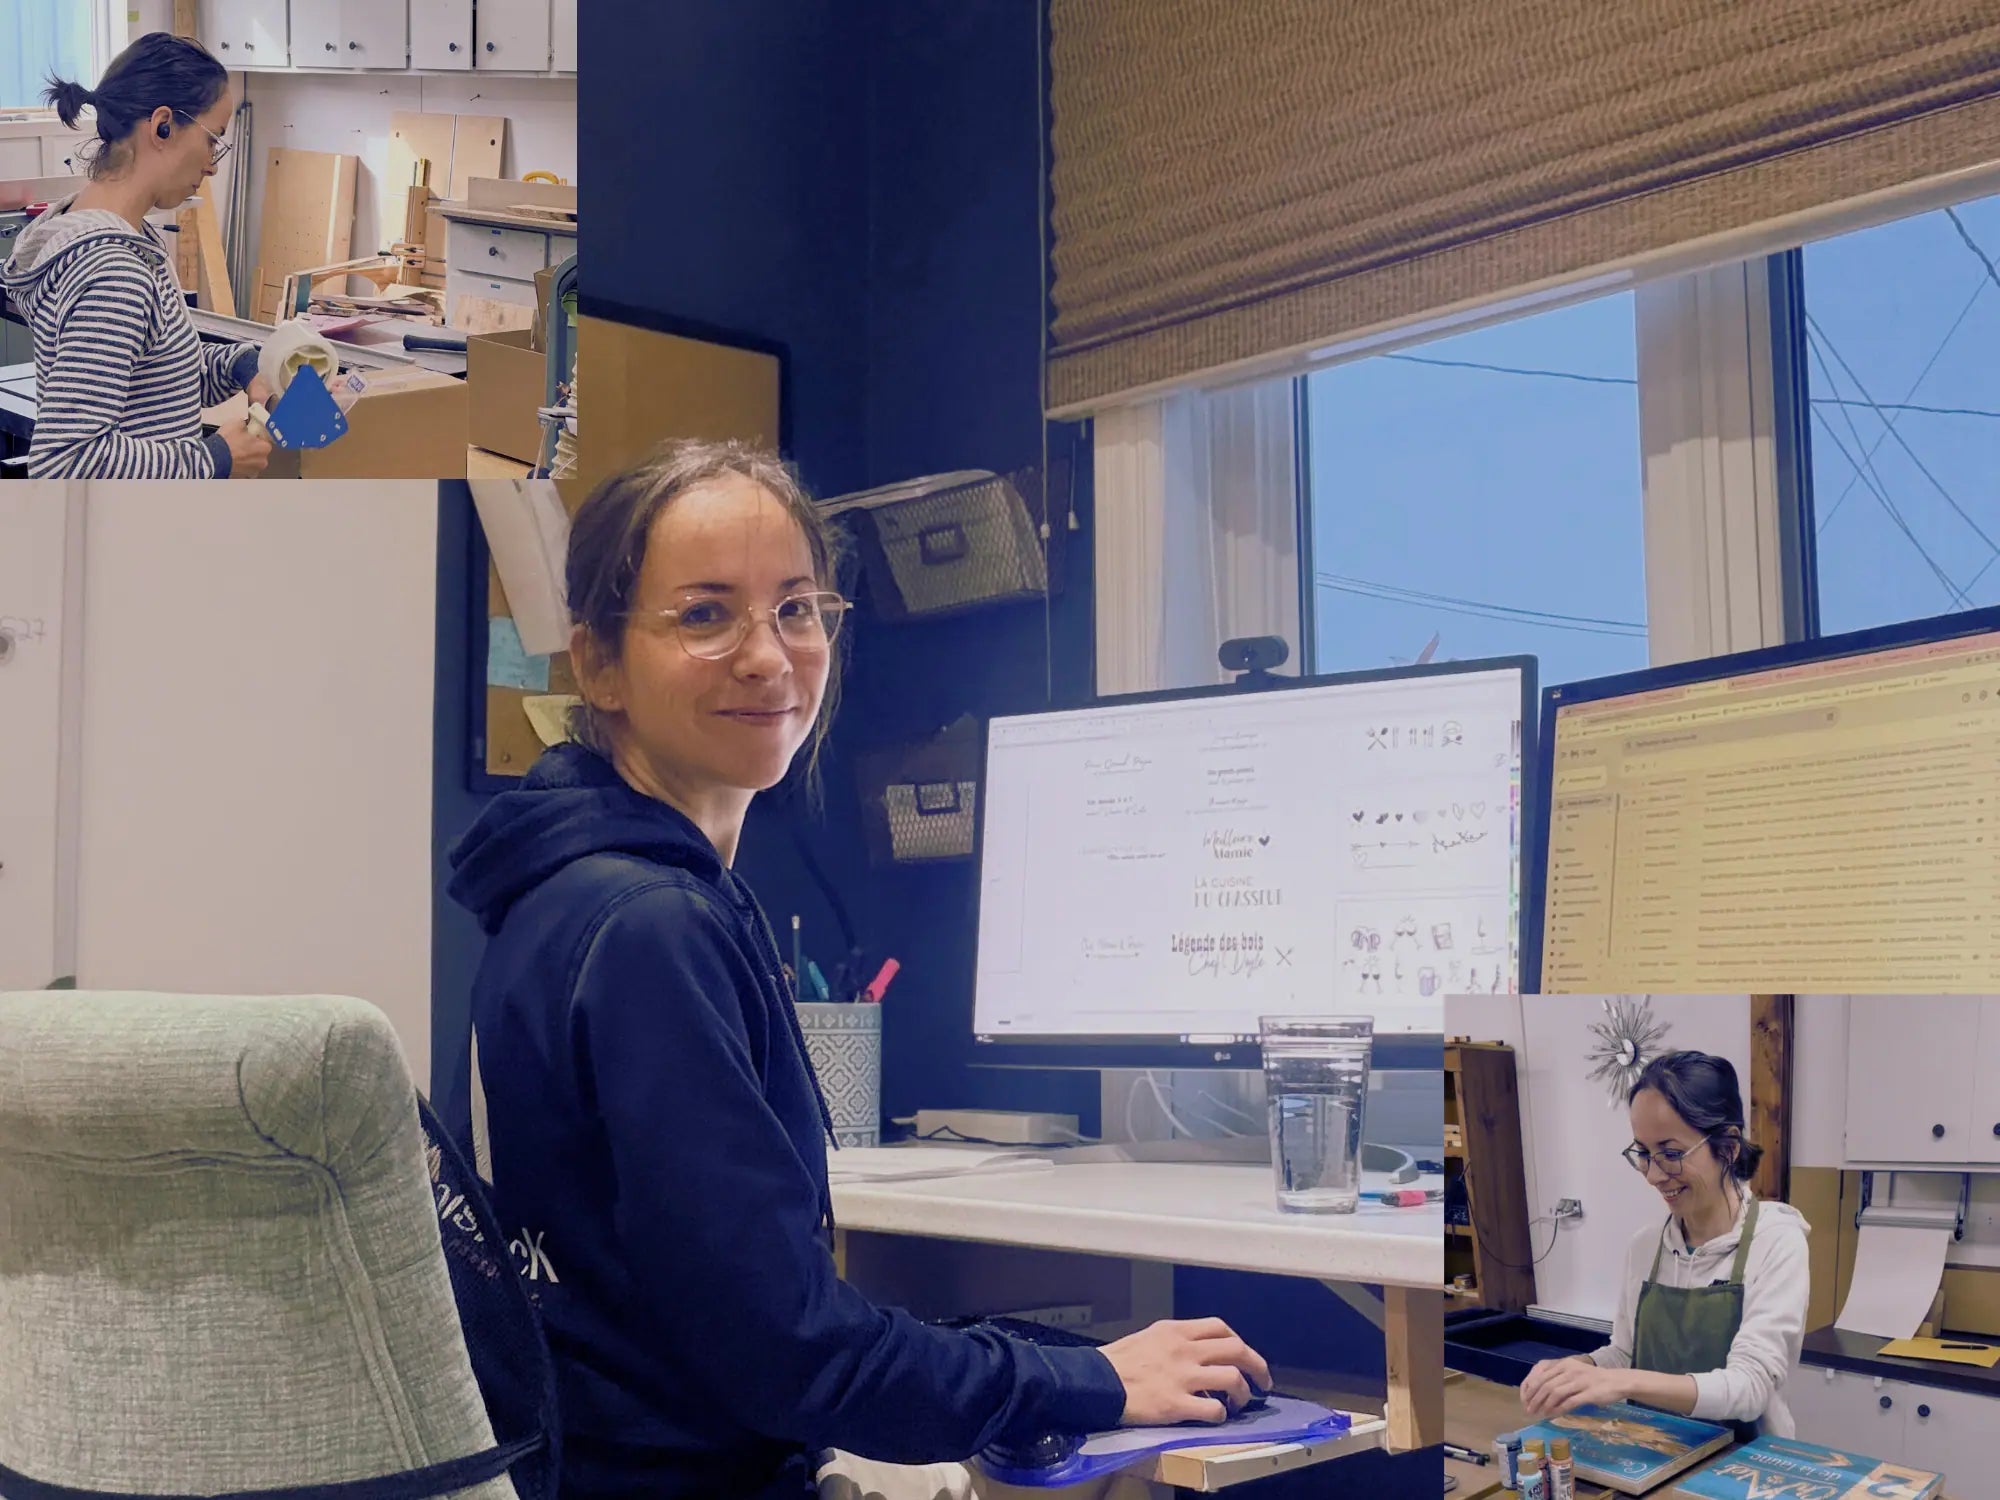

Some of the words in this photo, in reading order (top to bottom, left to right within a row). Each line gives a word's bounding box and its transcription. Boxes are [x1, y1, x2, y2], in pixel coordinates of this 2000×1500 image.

[1194, 876, 1208, 889] LA
[1211, 876, 1254, 888] CUISINE
[1171, 933, 1215, 956] Légende
[1219, 933, 1239, 951] des
[1241, 931, 1264, 951] bois
